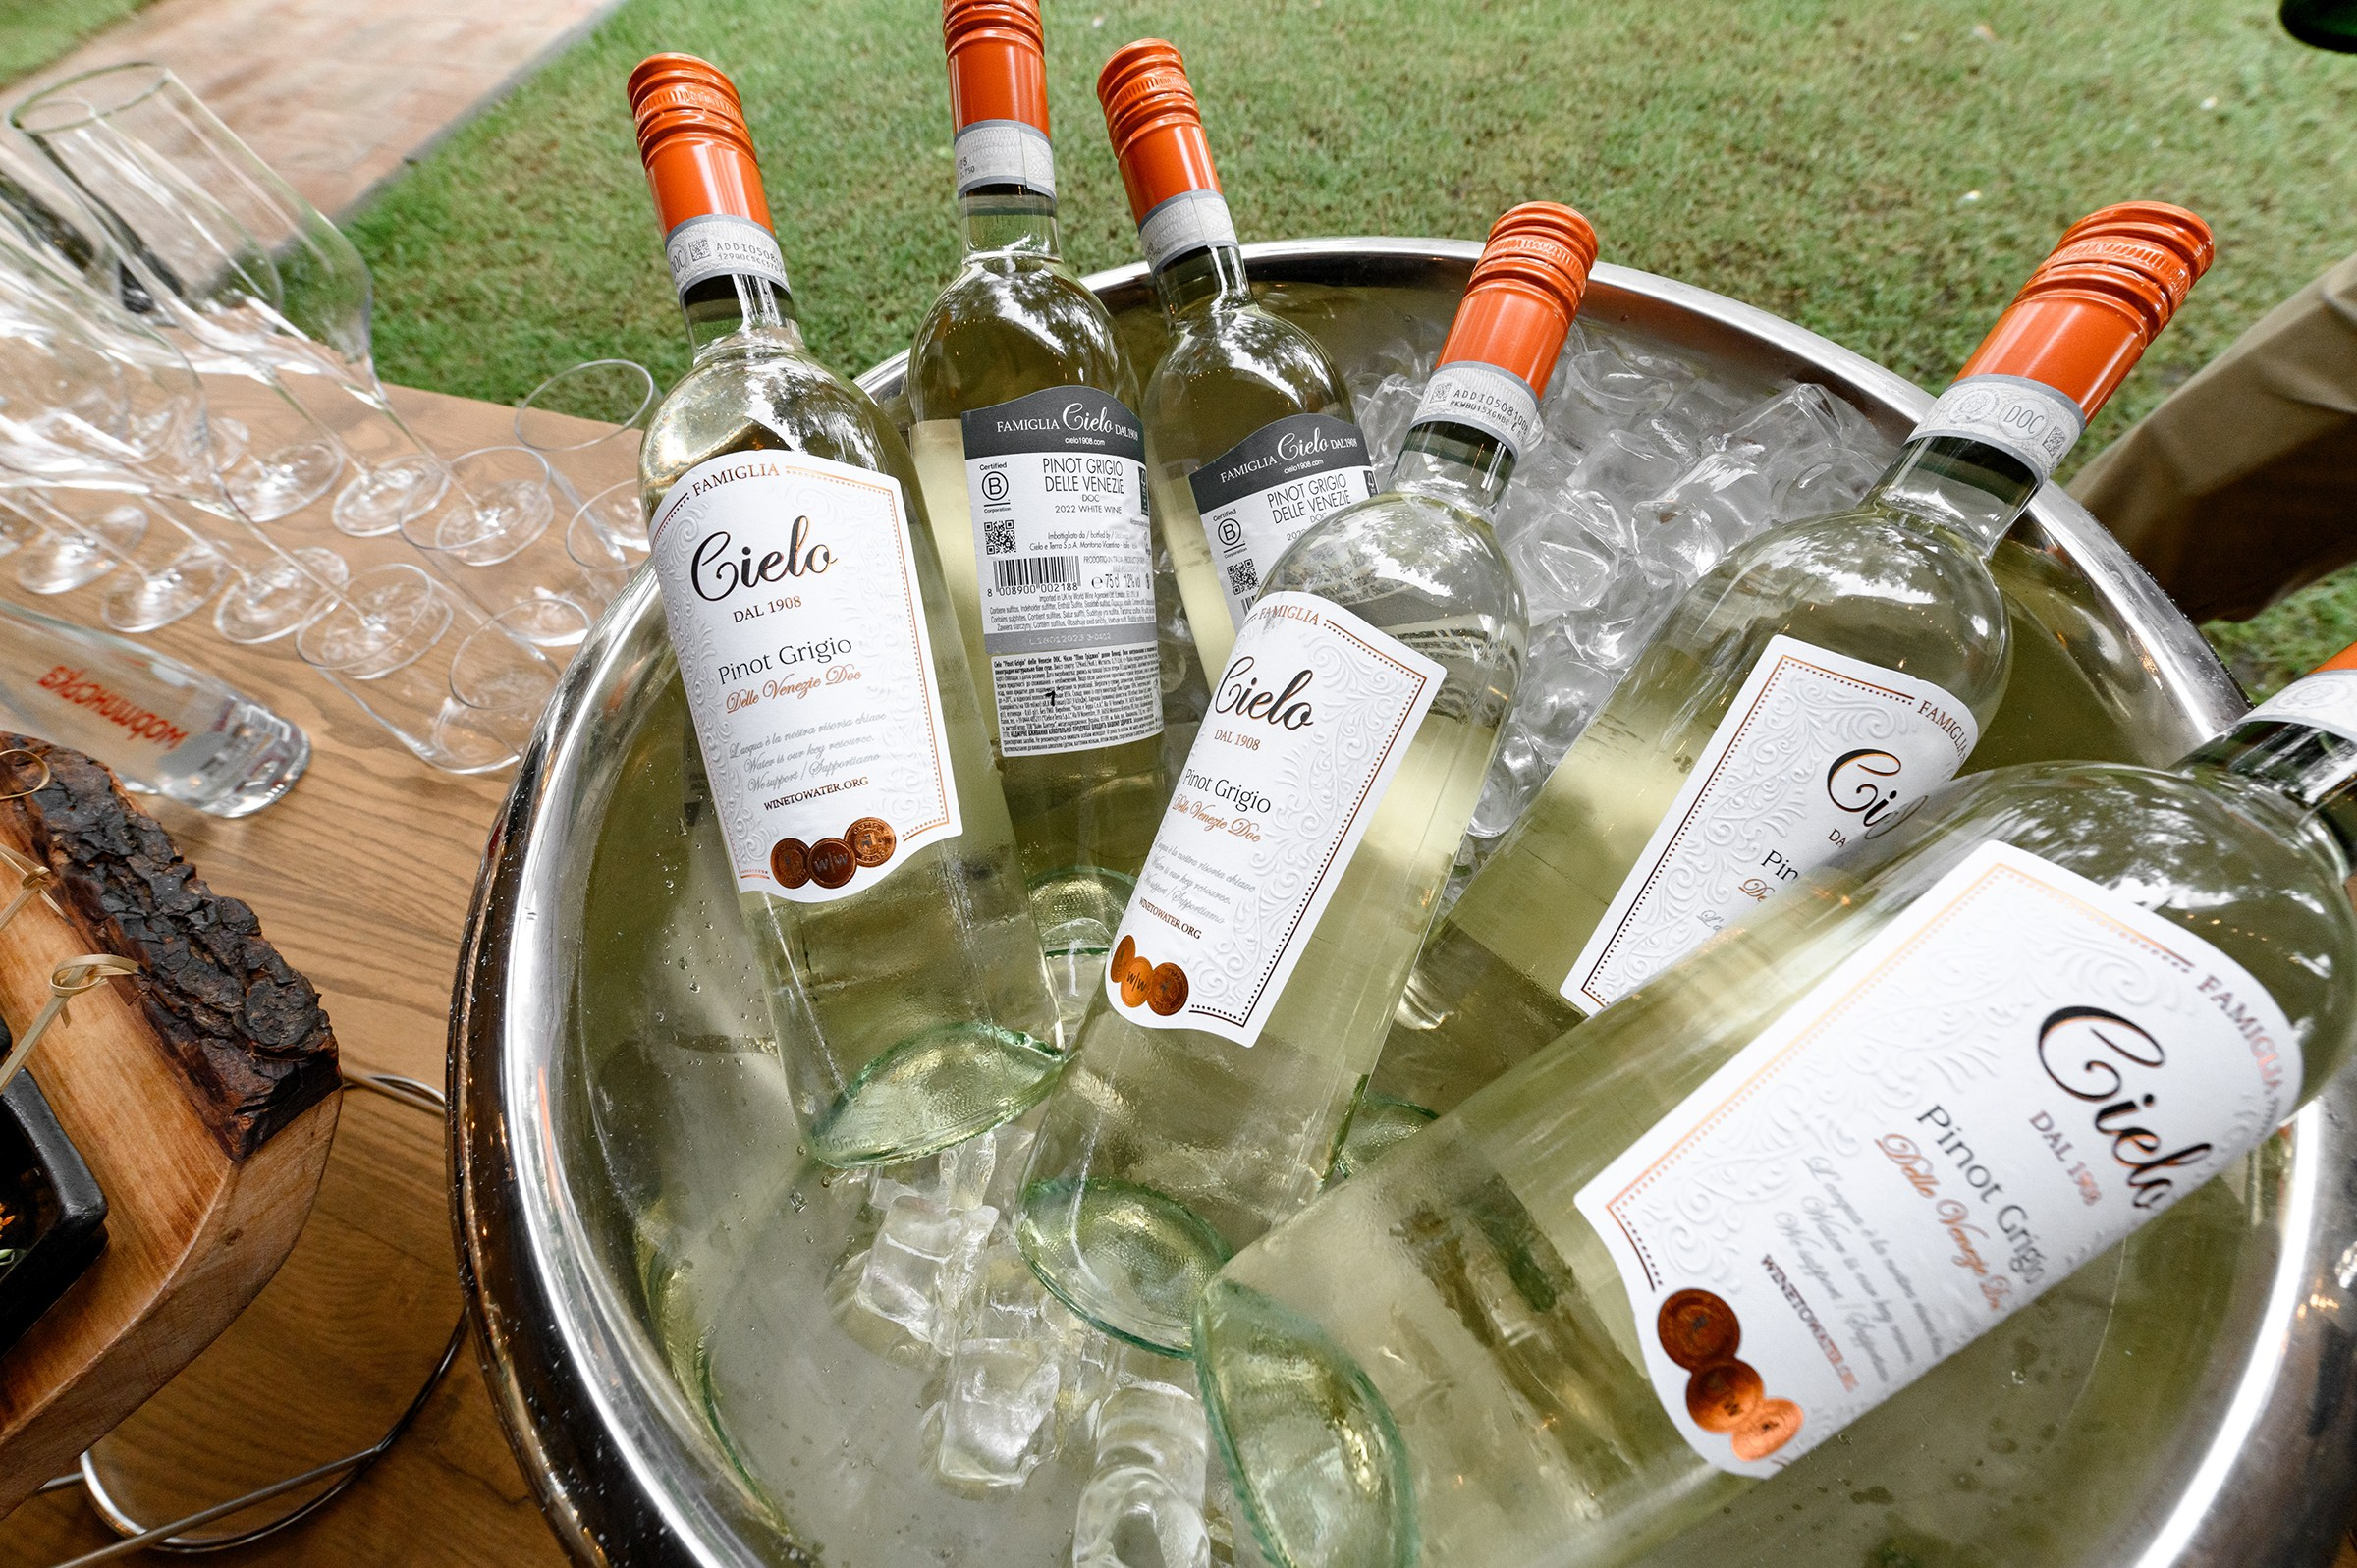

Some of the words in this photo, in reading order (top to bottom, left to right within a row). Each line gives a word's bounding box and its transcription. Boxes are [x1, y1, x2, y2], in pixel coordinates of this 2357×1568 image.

[996, 419, 1060, 433] FAMIGLIA
[1063, 403, 1113, 433] Cielo
[2003, 405, 2044, 434] DOC
[1065, 436, 1106, 446] cielo1908.com
[1220, 456, 1277, 483] FAMIGLIA
[1277, 427, 1329, 460] Cielo
[692, 463, 780, 497] FAMIGLIA
[979, 461, 1007, 471] Certified
[1043, 458, 1082, 474] PINOT
[1086, 458, 1124, 477] GRIGIO
[1284, 459, 1324, 474] cielo1908.com
[1045, 476, 1079, 493] DELLE
[1082, 476, 1124, 495] VENEZIE
[1082, 494, 1100, 503] DOC
[1267, 483, 1306, 508] PINOT
[1308, 473, 1346, 495] GRIGIO
[1055, 505, 1076, 514] 2022
[1080, 505, 1102, 514] WHITE
[1104, 506, 1123, 514] WINE
[1213, 509, 1236, 521] Certified
[1273, 502, 1306, 524] DELLE
[1307, 490, 1351, 513] VENEZIE
[1287, 528, 1306, 541] 202
[691, 515, 838, 602] Cielo
[999, 584, 1036, 596] 008900
[1041, 583, 1078, 594] 002188
[733, 605, 764, 623] DAL
[768, 595, 802, 613] 1908
[1259, 605, 1320, 627] FAMIGLIA
[718, 654, 773, 686] Pinot
[778, 637, 852, 665] Grigio
[726, 689, 759, 715] Delle
[762, 673, 822, 700] Venezie
[825, 664, 862, 686] Doc
[1215, 656, 1314, 731] Cielo
[729, 742, 765, 760] L'acqua
[772, 732, 783, 747] la
[784, 726, 817, 742] nostra
[854, 712, 887, 727] chiave
[1214, 729, 1235, 744] DAL
[1235, 734, 1261, 752] 1908
[1917, 699, 1967, 758] FAMIGLIA
[743, 752, 775, 775] Water
[776, 751, 785, 765] is
[787, 750, 805, 763] our
[806, 742, 826, 759] key
[828, 735, 875, 752] resource.
[747, 772, 770, 794] We
[766, 770, 798, 791] support
[808, 752, 882, 779] Supportiamo
[764, 776, 869, 812] WINETOWATER.ORG
[1182, 768, 1213, 792] Pinot
[1214, 780, 1272, 814] Grigio
[1190, 801, 1228, 832] Venezie
[1228, 818, 1261, 843] Doc
[1828, 829, 1847, 849] DA
[1761, 849, 1799, 881] Pin
[1138, 896, 1202, 940] WINETOWATER.ORG
[2038, 1005, 2214, 1210] Cielo
[2029, 1109, 2073, 1163] DAL
[1916, 1104, 2004, 1204] Pinot
[1874, 1133, 1941, 1199] Delle
[1935, 1198, 1991, 1275] Venezie
